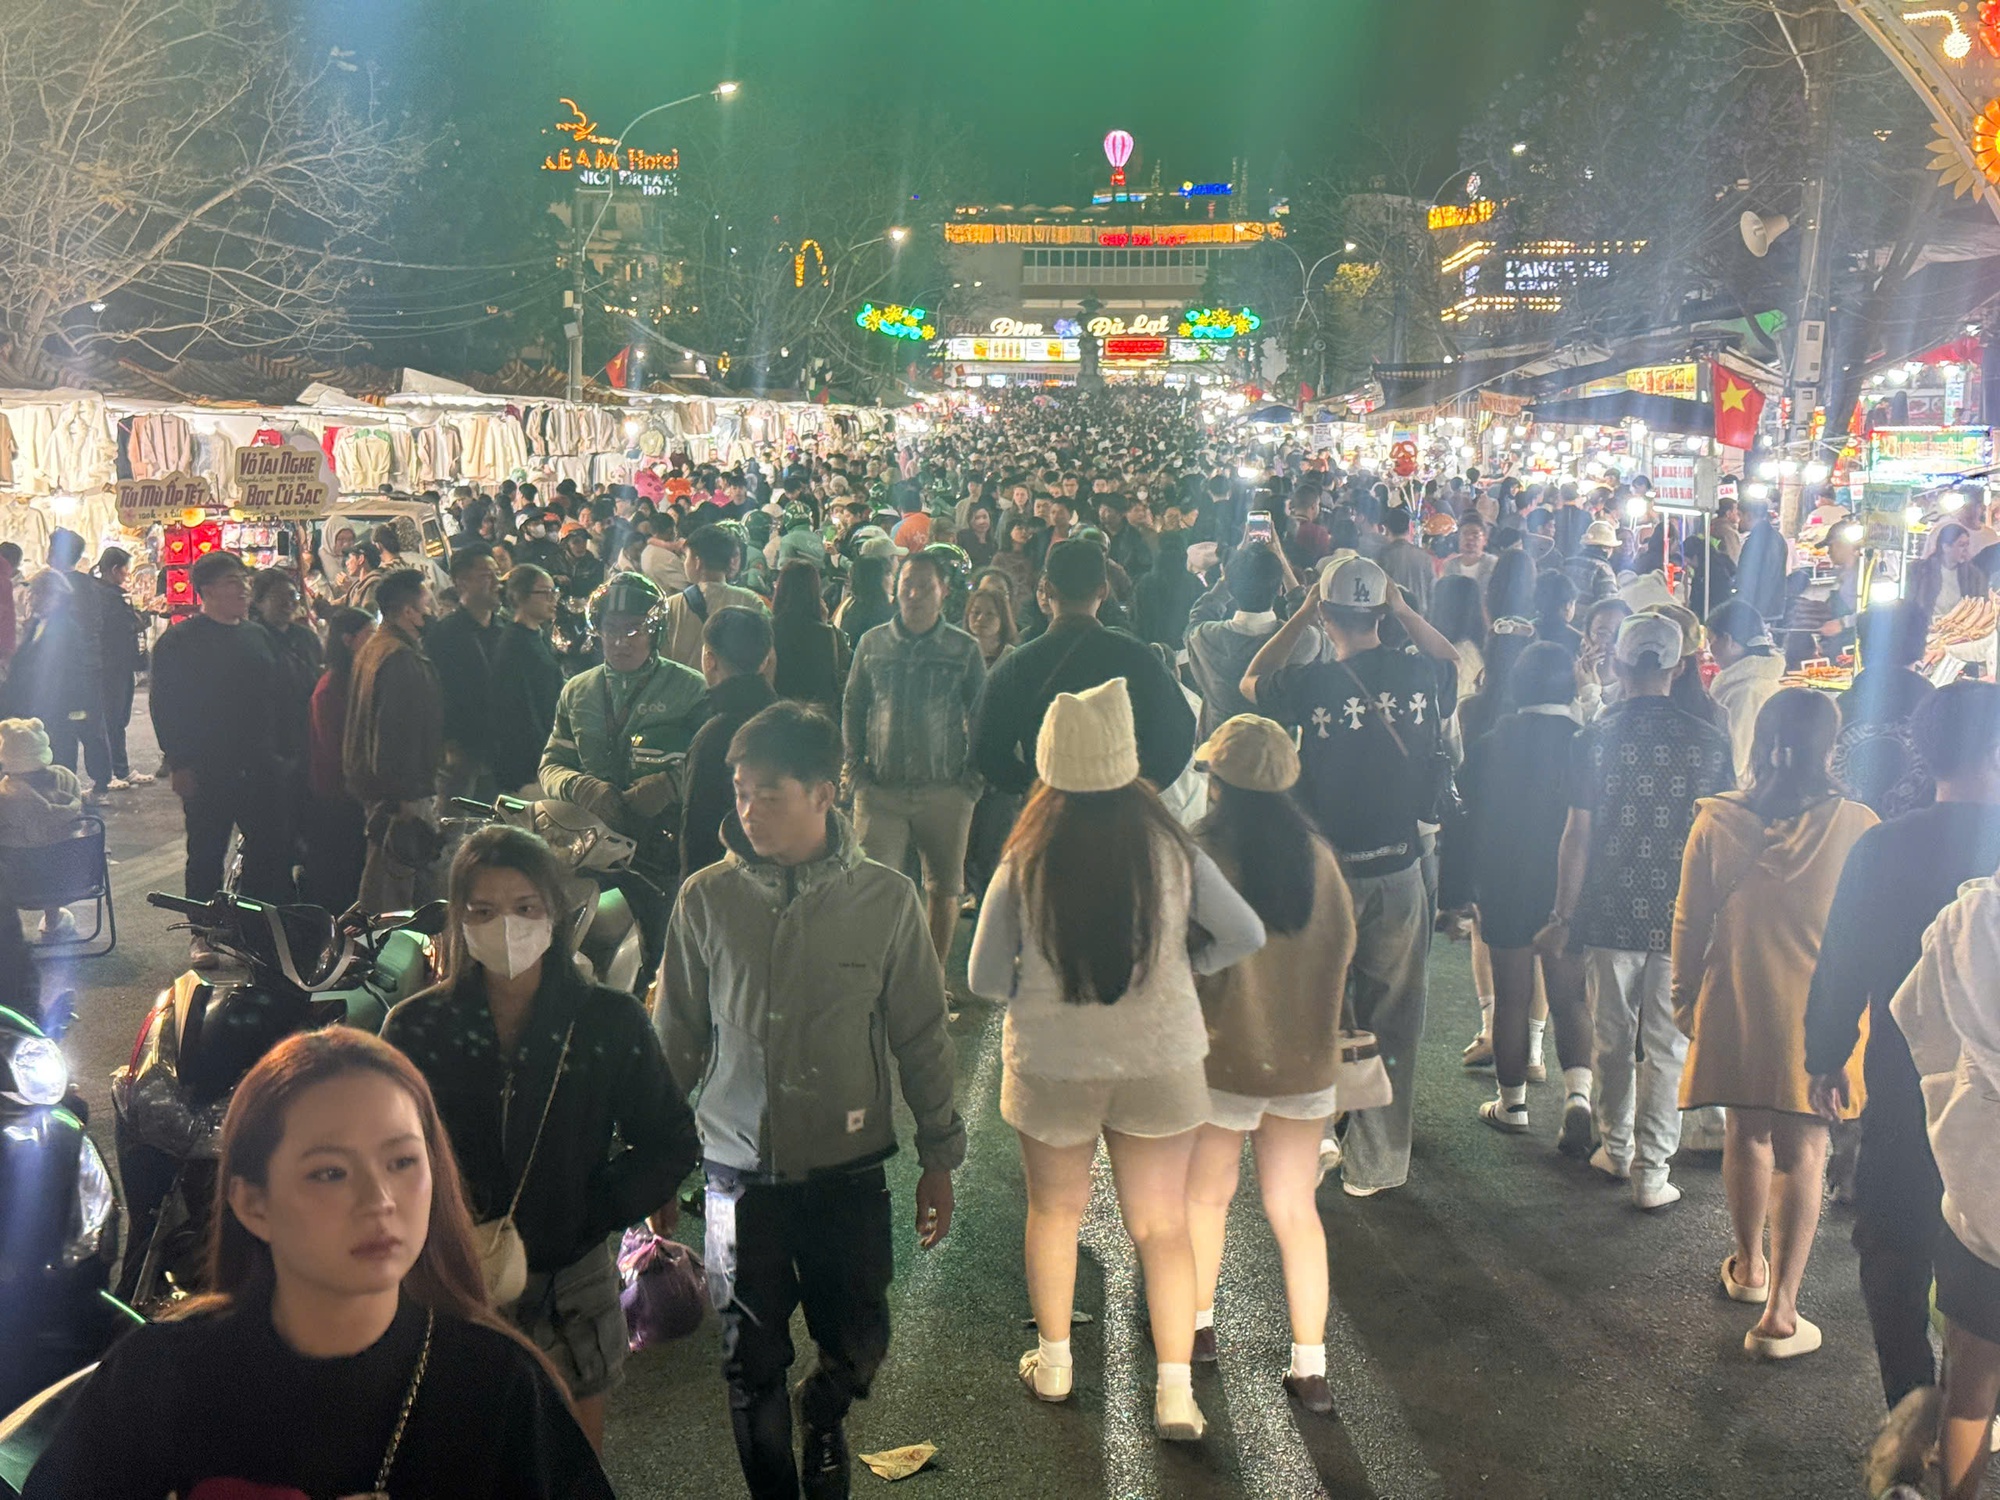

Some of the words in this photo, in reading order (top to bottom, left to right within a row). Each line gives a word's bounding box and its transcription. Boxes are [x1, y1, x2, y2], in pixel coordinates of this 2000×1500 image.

[628, 149, 679, 170] Hotel
[1086, 316, 1127, 337] Đà
[1127, 314, 1170, 337] Lạt
[1353, 577, 1370, 602] LA
